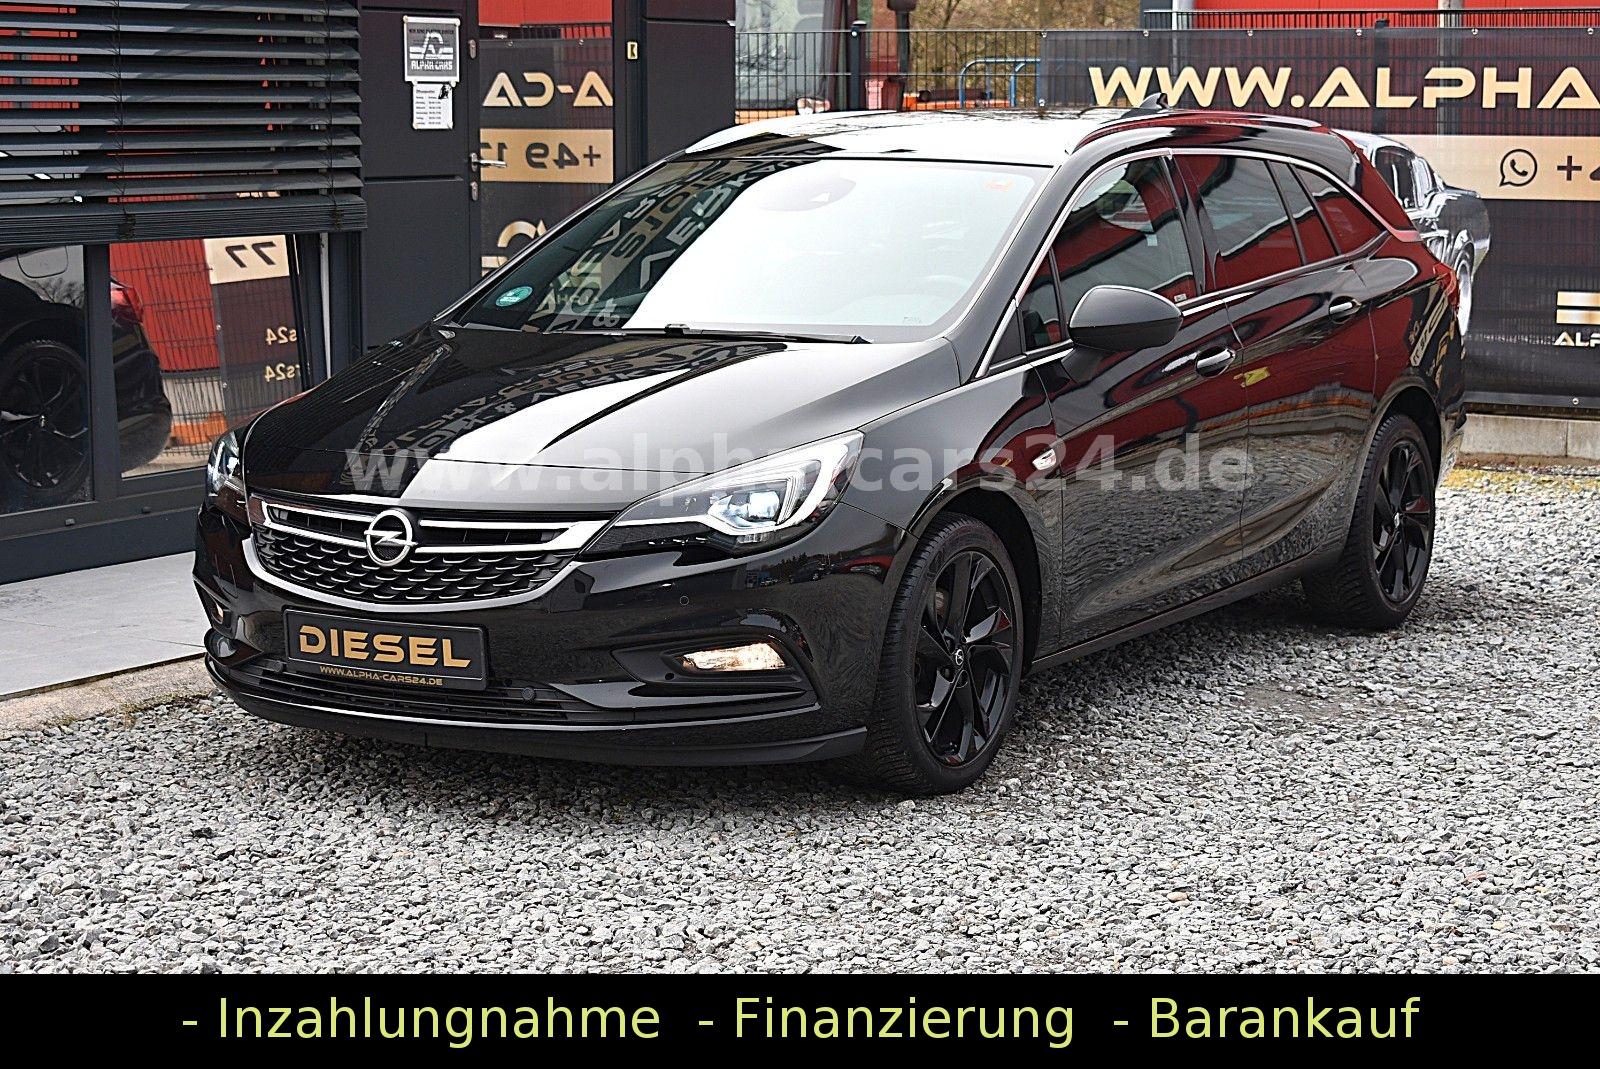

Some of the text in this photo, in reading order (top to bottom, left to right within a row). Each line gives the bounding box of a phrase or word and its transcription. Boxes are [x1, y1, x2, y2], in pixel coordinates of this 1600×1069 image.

[1089, 66, 1600, 109] WWW.ALPHA
[299, 625, 471, 668] DIESEL
[319, 665, 443, 686] WWW.ALPHA-CARS24.DE
